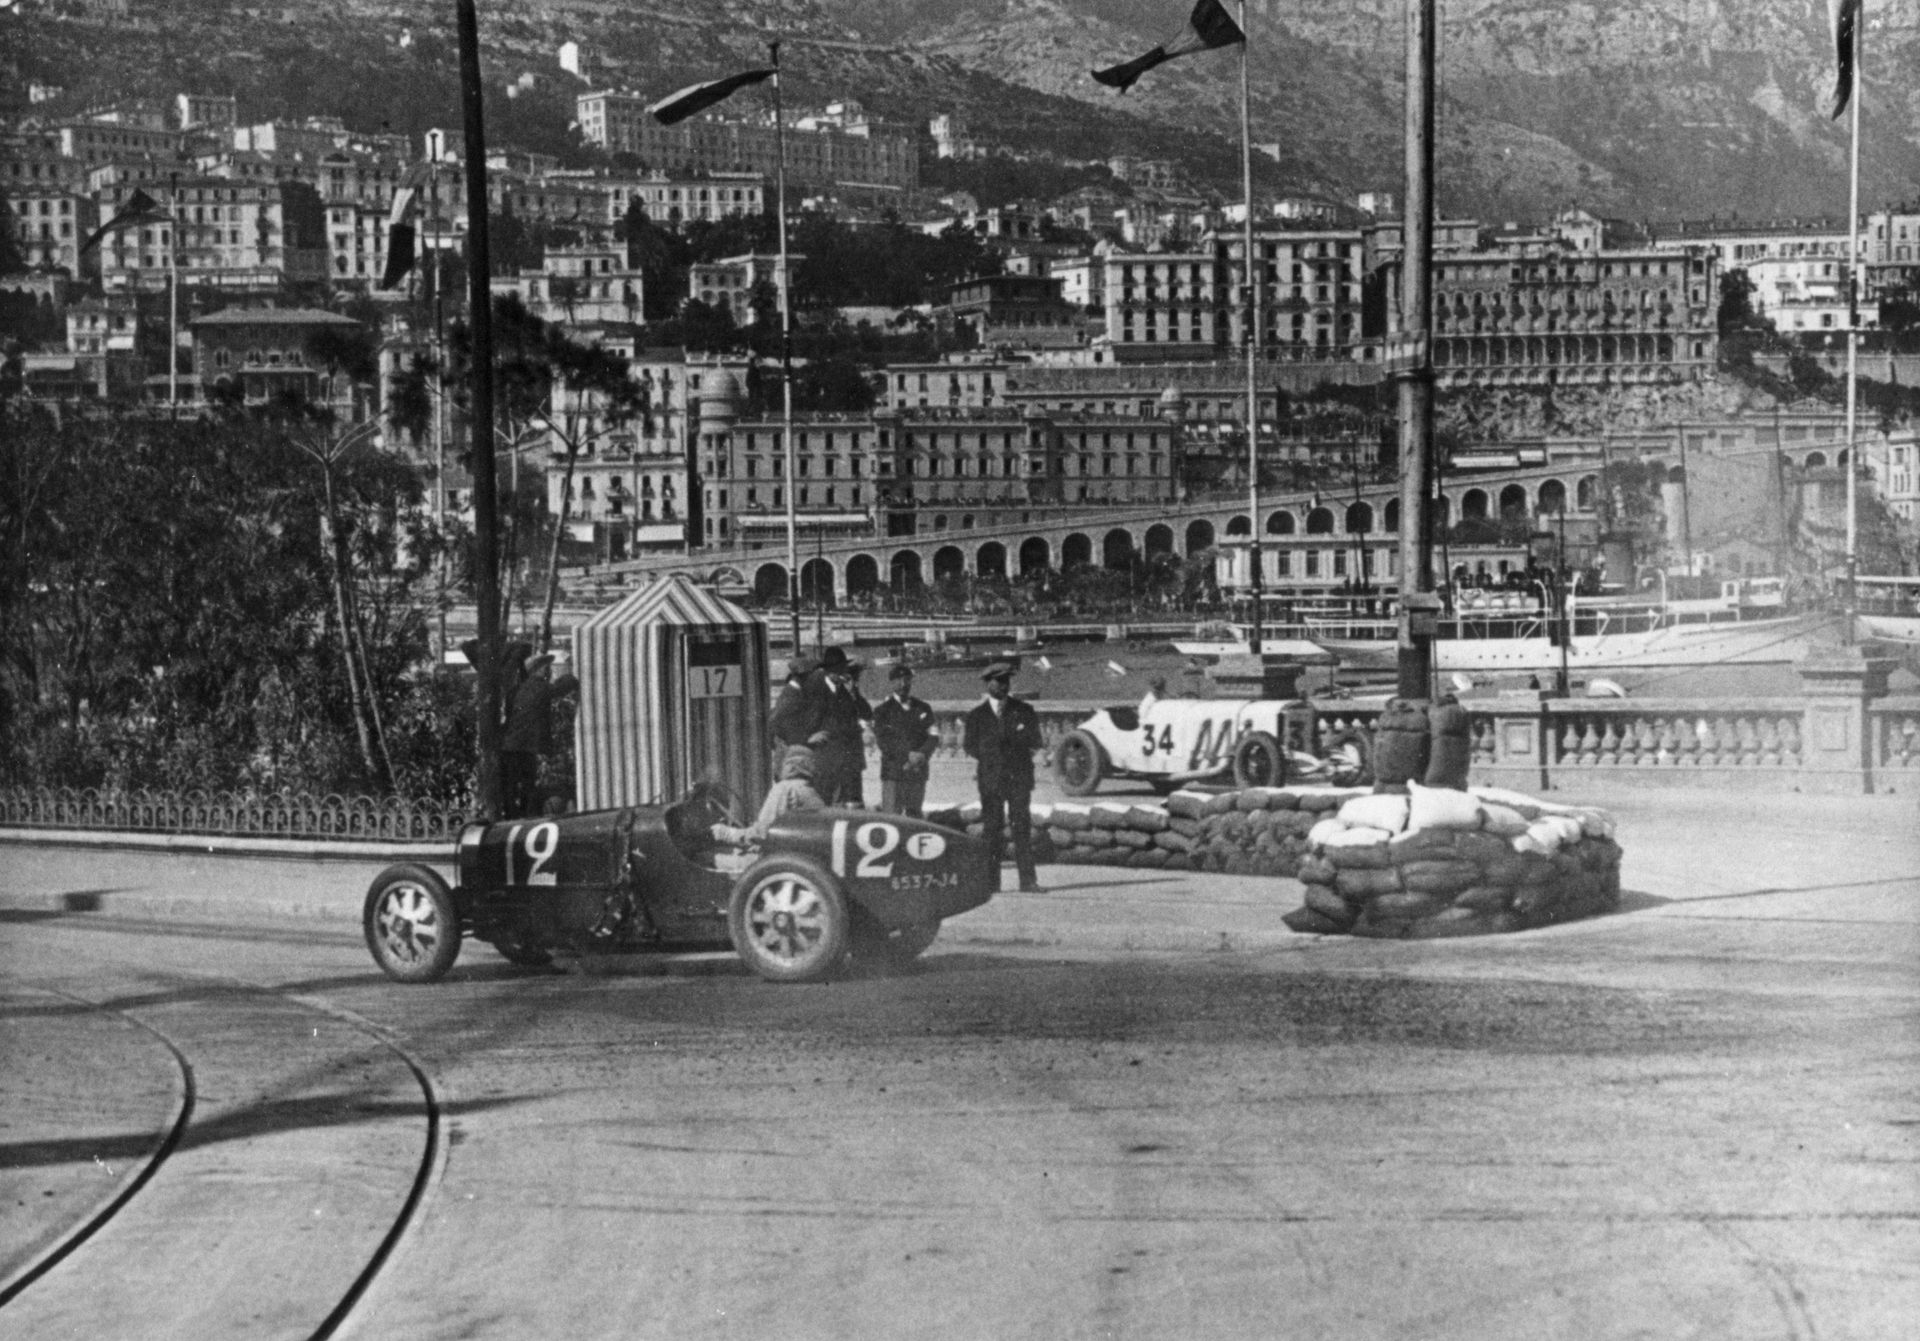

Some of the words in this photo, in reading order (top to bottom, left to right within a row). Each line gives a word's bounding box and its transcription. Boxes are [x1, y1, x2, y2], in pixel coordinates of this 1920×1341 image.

[704, 668, 728, 695] 17
[1142, 723, 1174, 756] 34
[505, 822, 559, 886] 12
[832, 820, 899, 877] 12
[918, 835, 932, 856] F
